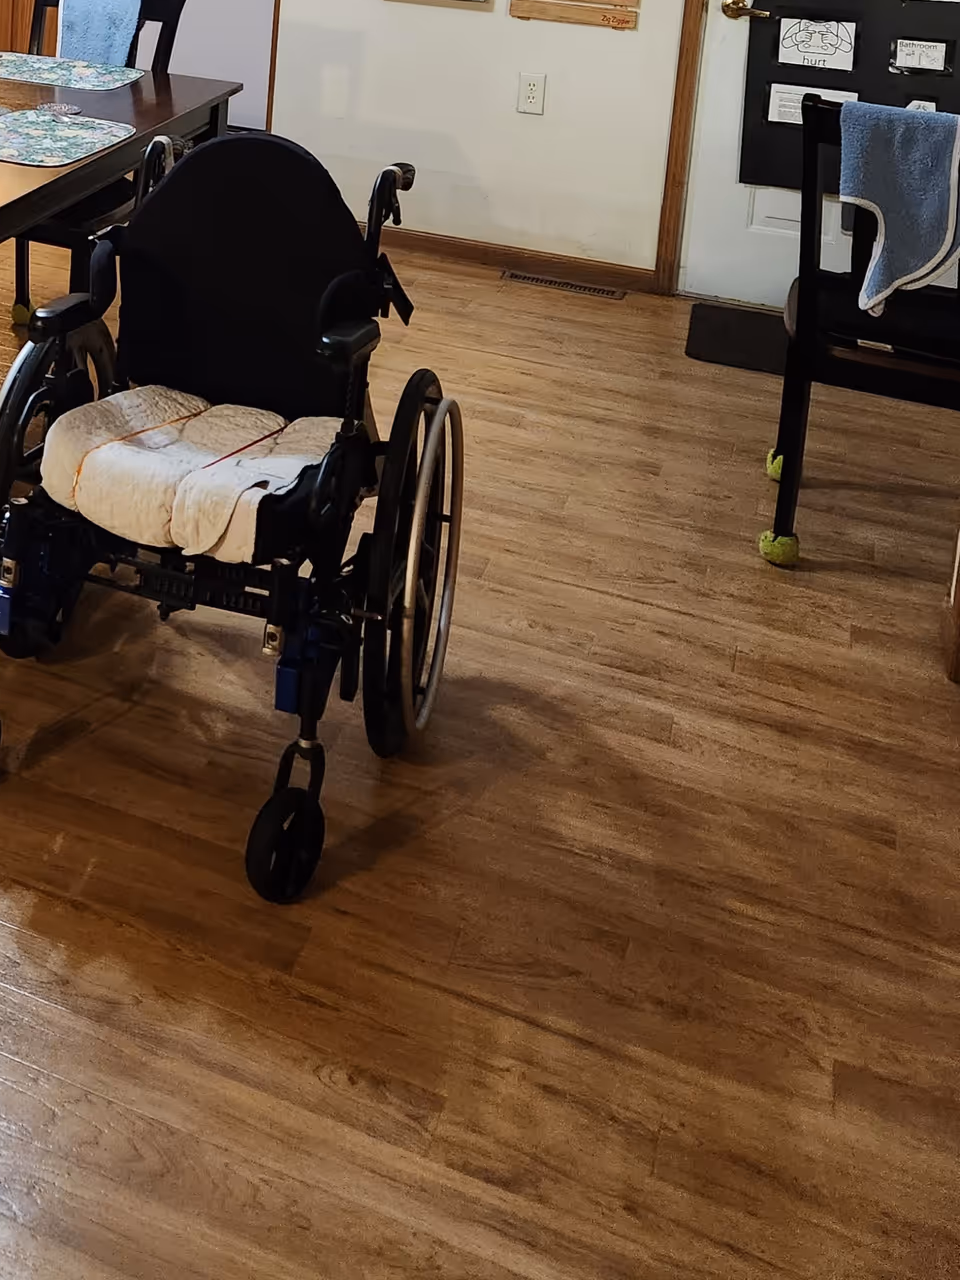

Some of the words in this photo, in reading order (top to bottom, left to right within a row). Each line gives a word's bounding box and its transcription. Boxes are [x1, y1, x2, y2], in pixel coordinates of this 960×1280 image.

[601, 14, 611, 24] Zig
[899, 41, 938, 50] Bathroom
[802, 55, 827, 67] hurt
